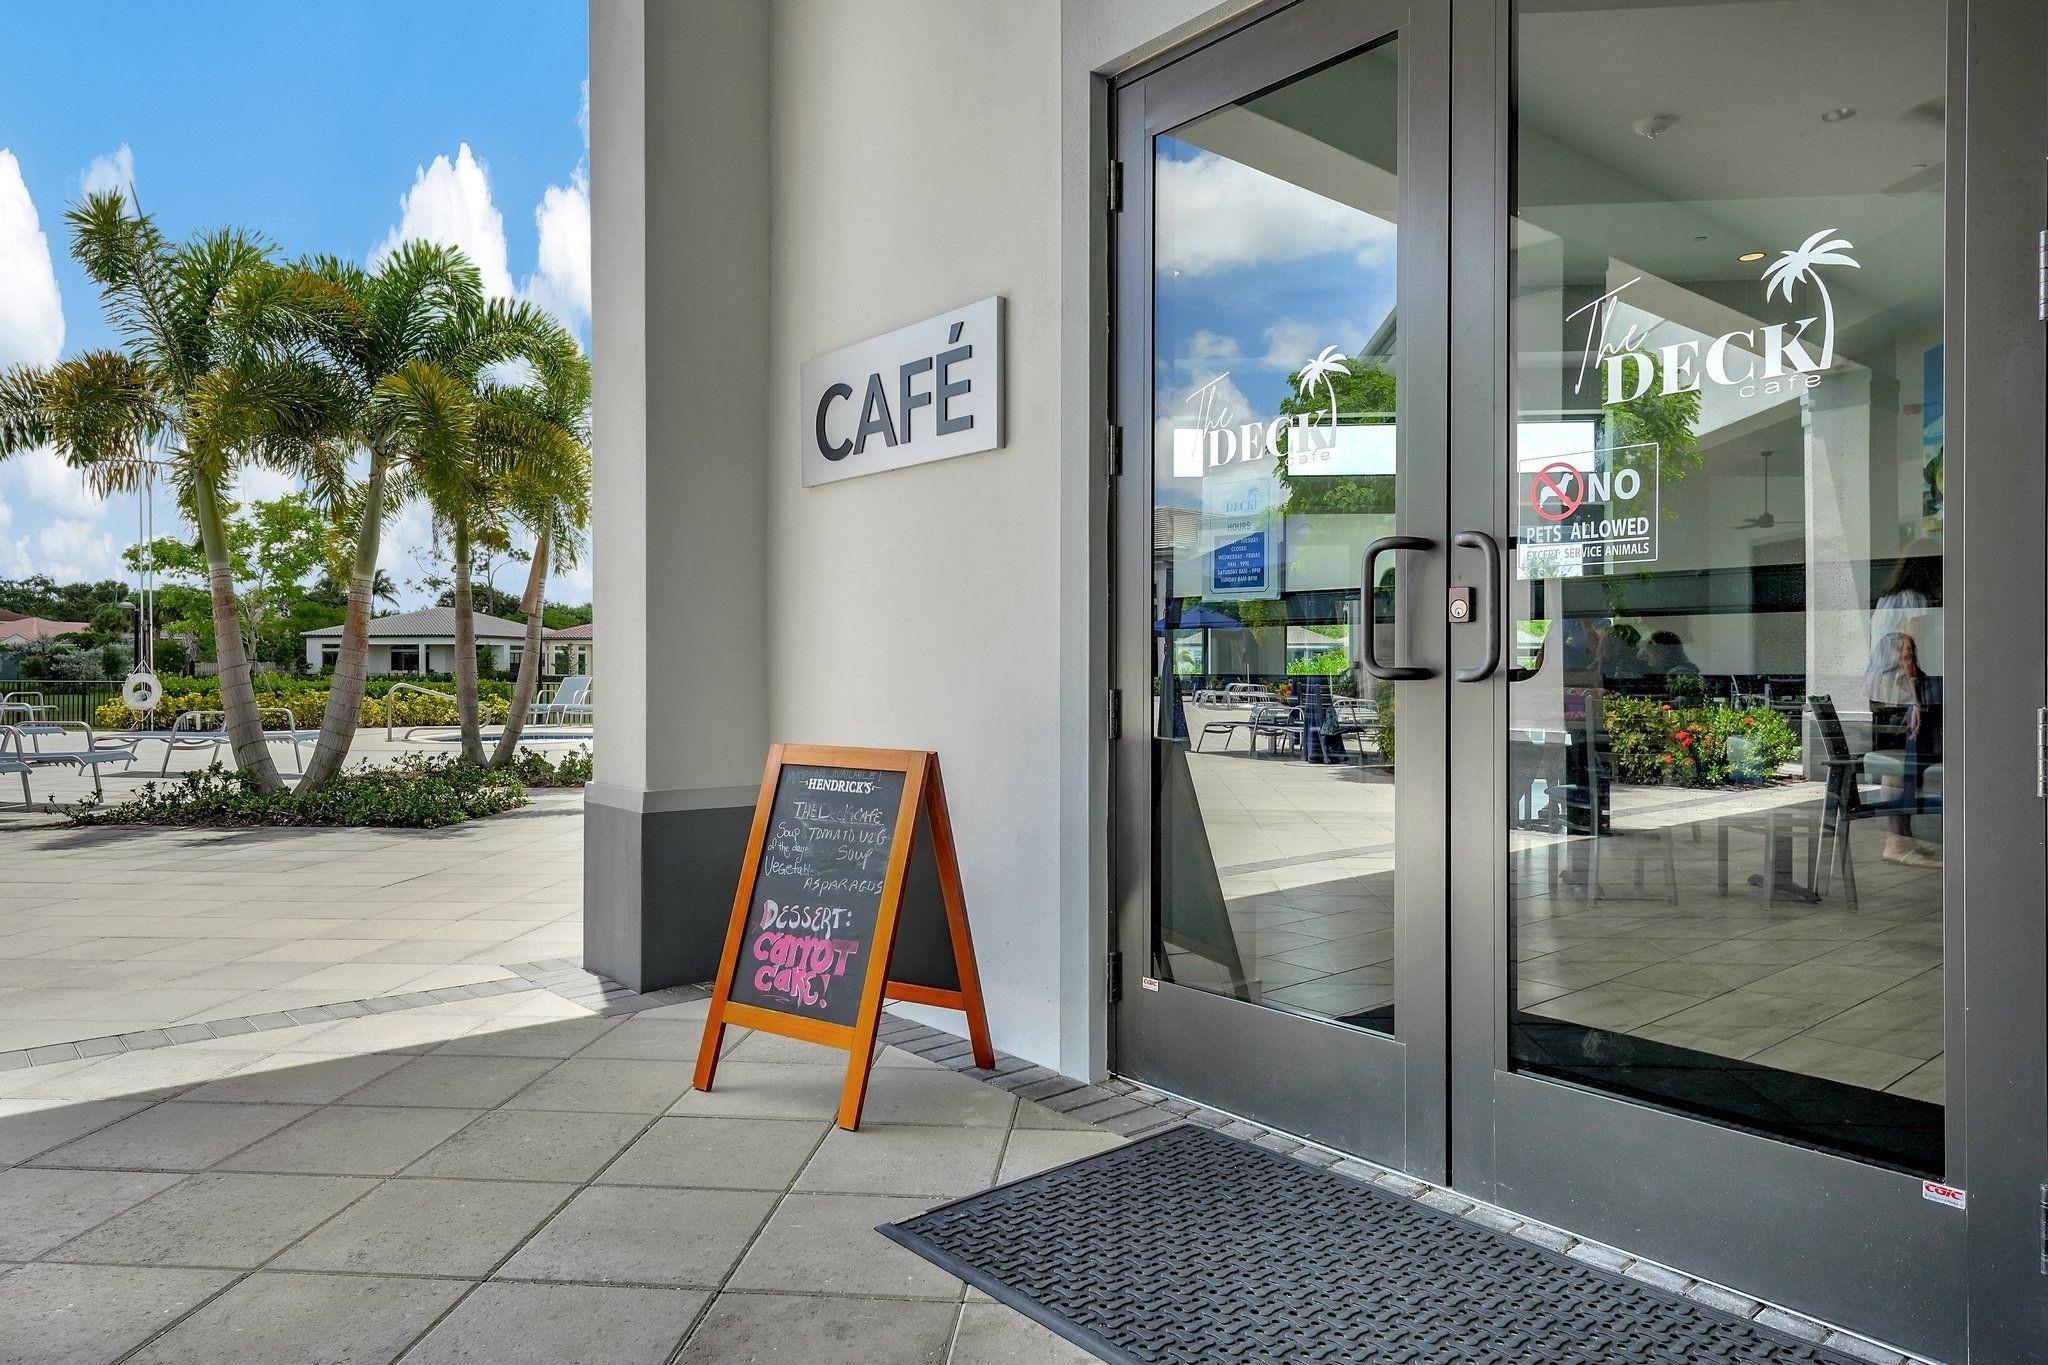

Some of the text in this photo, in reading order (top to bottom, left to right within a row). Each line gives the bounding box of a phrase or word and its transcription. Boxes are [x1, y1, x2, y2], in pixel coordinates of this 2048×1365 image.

[1566, 276, 1648, 394] The
[1602, 317, 1822, 405] DECK
[816, 321, 973, 461] CAFÉ
[1739, 374, 1821, 398] cafe
[1186, 371, 1236, 458] The
[1208, 409, 1331, 467] DECK
[1285, 450, 1330, 466] cafe
[1588, 468, 1641, 503] NO
[1227, 521, 1251, 532] HOURS
[1526, 517, 1649, 543] PETS ALLOWED
[1526, 543, 1649, 560] EXCEPT SERVICE ANIMALS
[808, 778, 872, 794] HENDRICK'S
[776, 821, 800, 841] Soup
